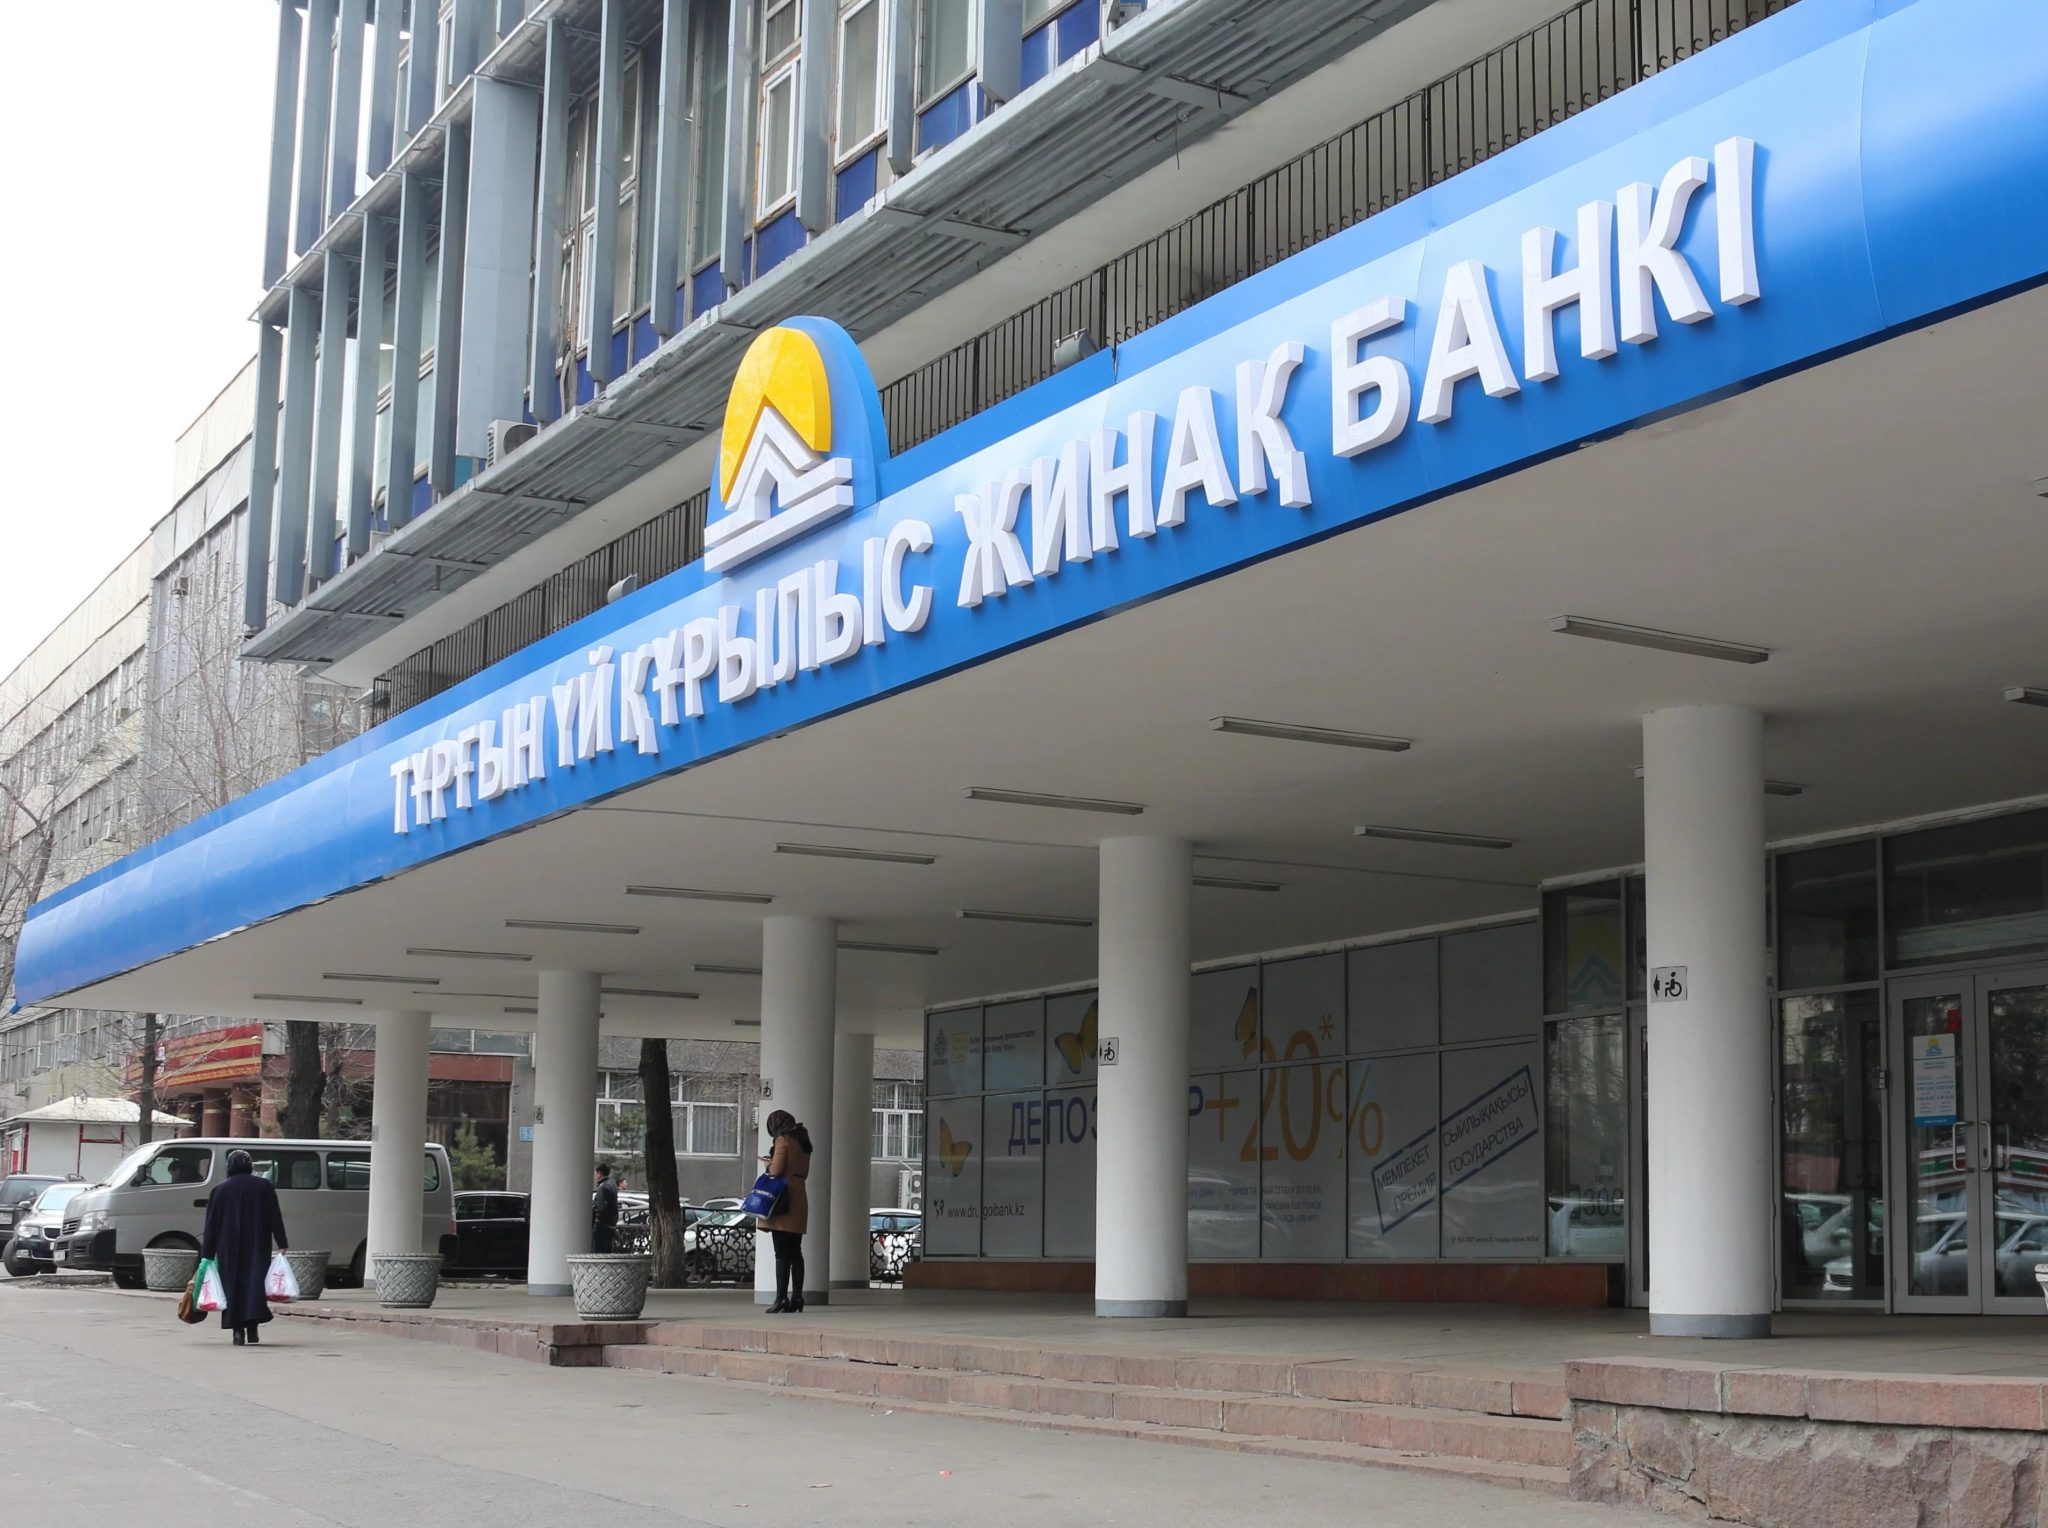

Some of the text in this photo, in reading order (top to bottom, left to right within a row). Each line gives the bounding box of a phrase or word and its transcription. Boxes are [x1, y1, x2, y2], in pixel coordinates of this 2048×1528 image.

[390, 135, 1761, 834] ТҰРҒЫН ҮЙ ҚҰРЫЛЫС ЖИНАҚ БАНКІ
[1376, 1144, 1430, 1191] МЕМЛЕКЕТ
[1393, 1117, 1524, 1212] ПРЕМИЯ ГОСУДАРСТВА
